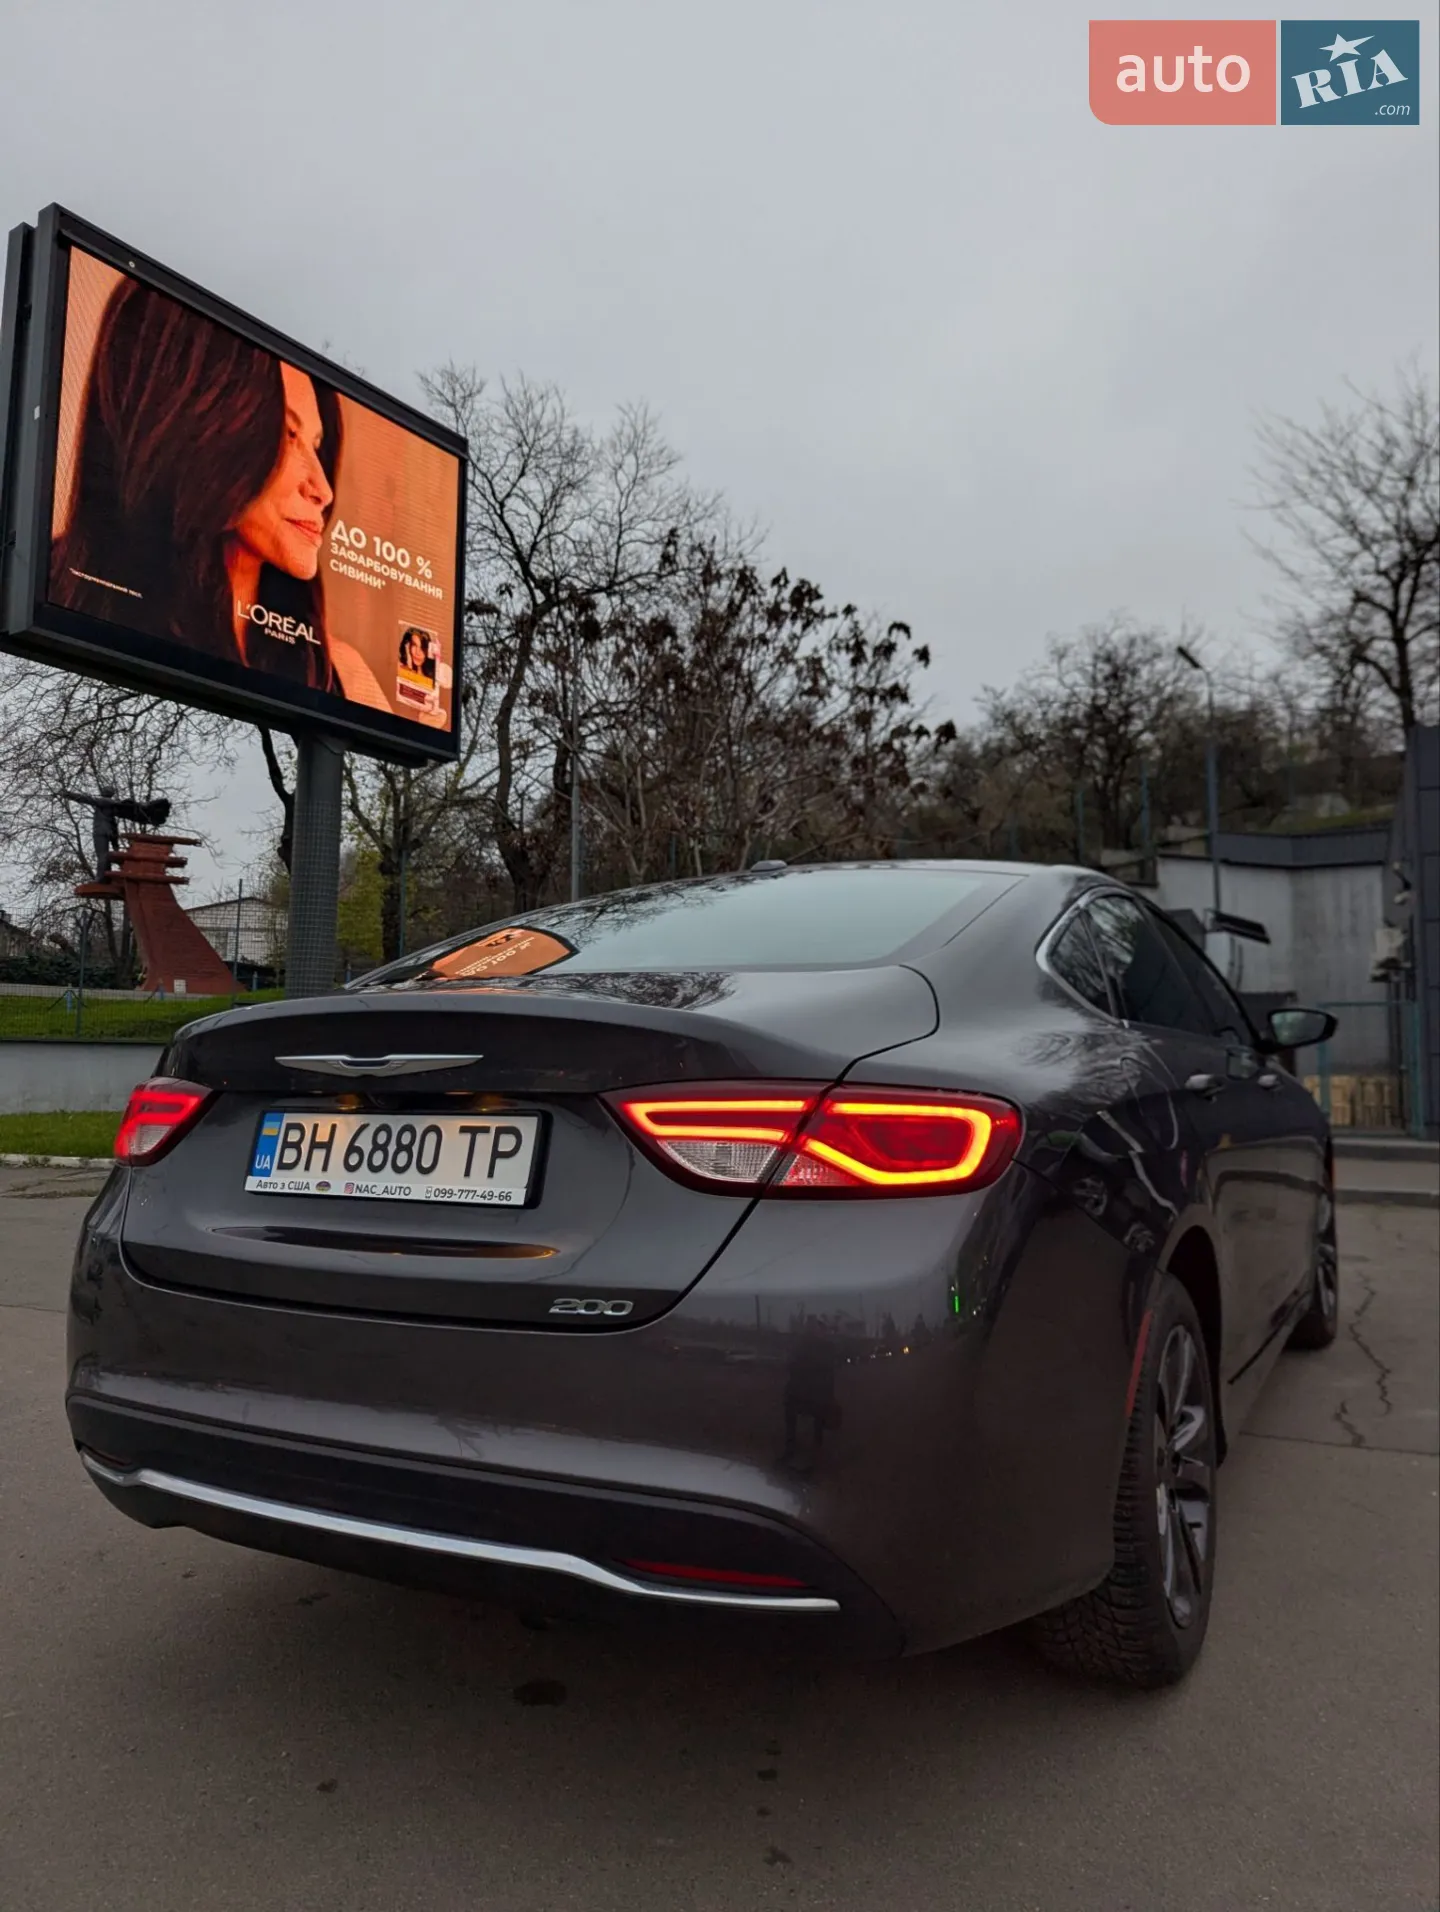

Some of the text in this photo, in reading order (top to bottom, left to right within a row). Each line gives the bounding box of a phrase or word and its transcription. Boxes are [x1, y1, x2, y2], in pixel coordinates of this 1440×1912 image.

[331, 519, 433, 579] ДО 100 %
[330, 542, 443, 600] ЗАФАРБОВУВАННЯ
[264, 627, 296, 645] PARIS
[277, 1122, 523, 1178] BH 6880 TP
[255, 1153, 271, 1170] UA
[256, 1180, 278, 1189] Авто
[288, 1181, 310, 1191] США
[355, 1184, 412, 1196] NAC_AUTO
[433, 1188, 512, 1201] 099-777-49-66
[549, 1298, 634, 1316] 200
